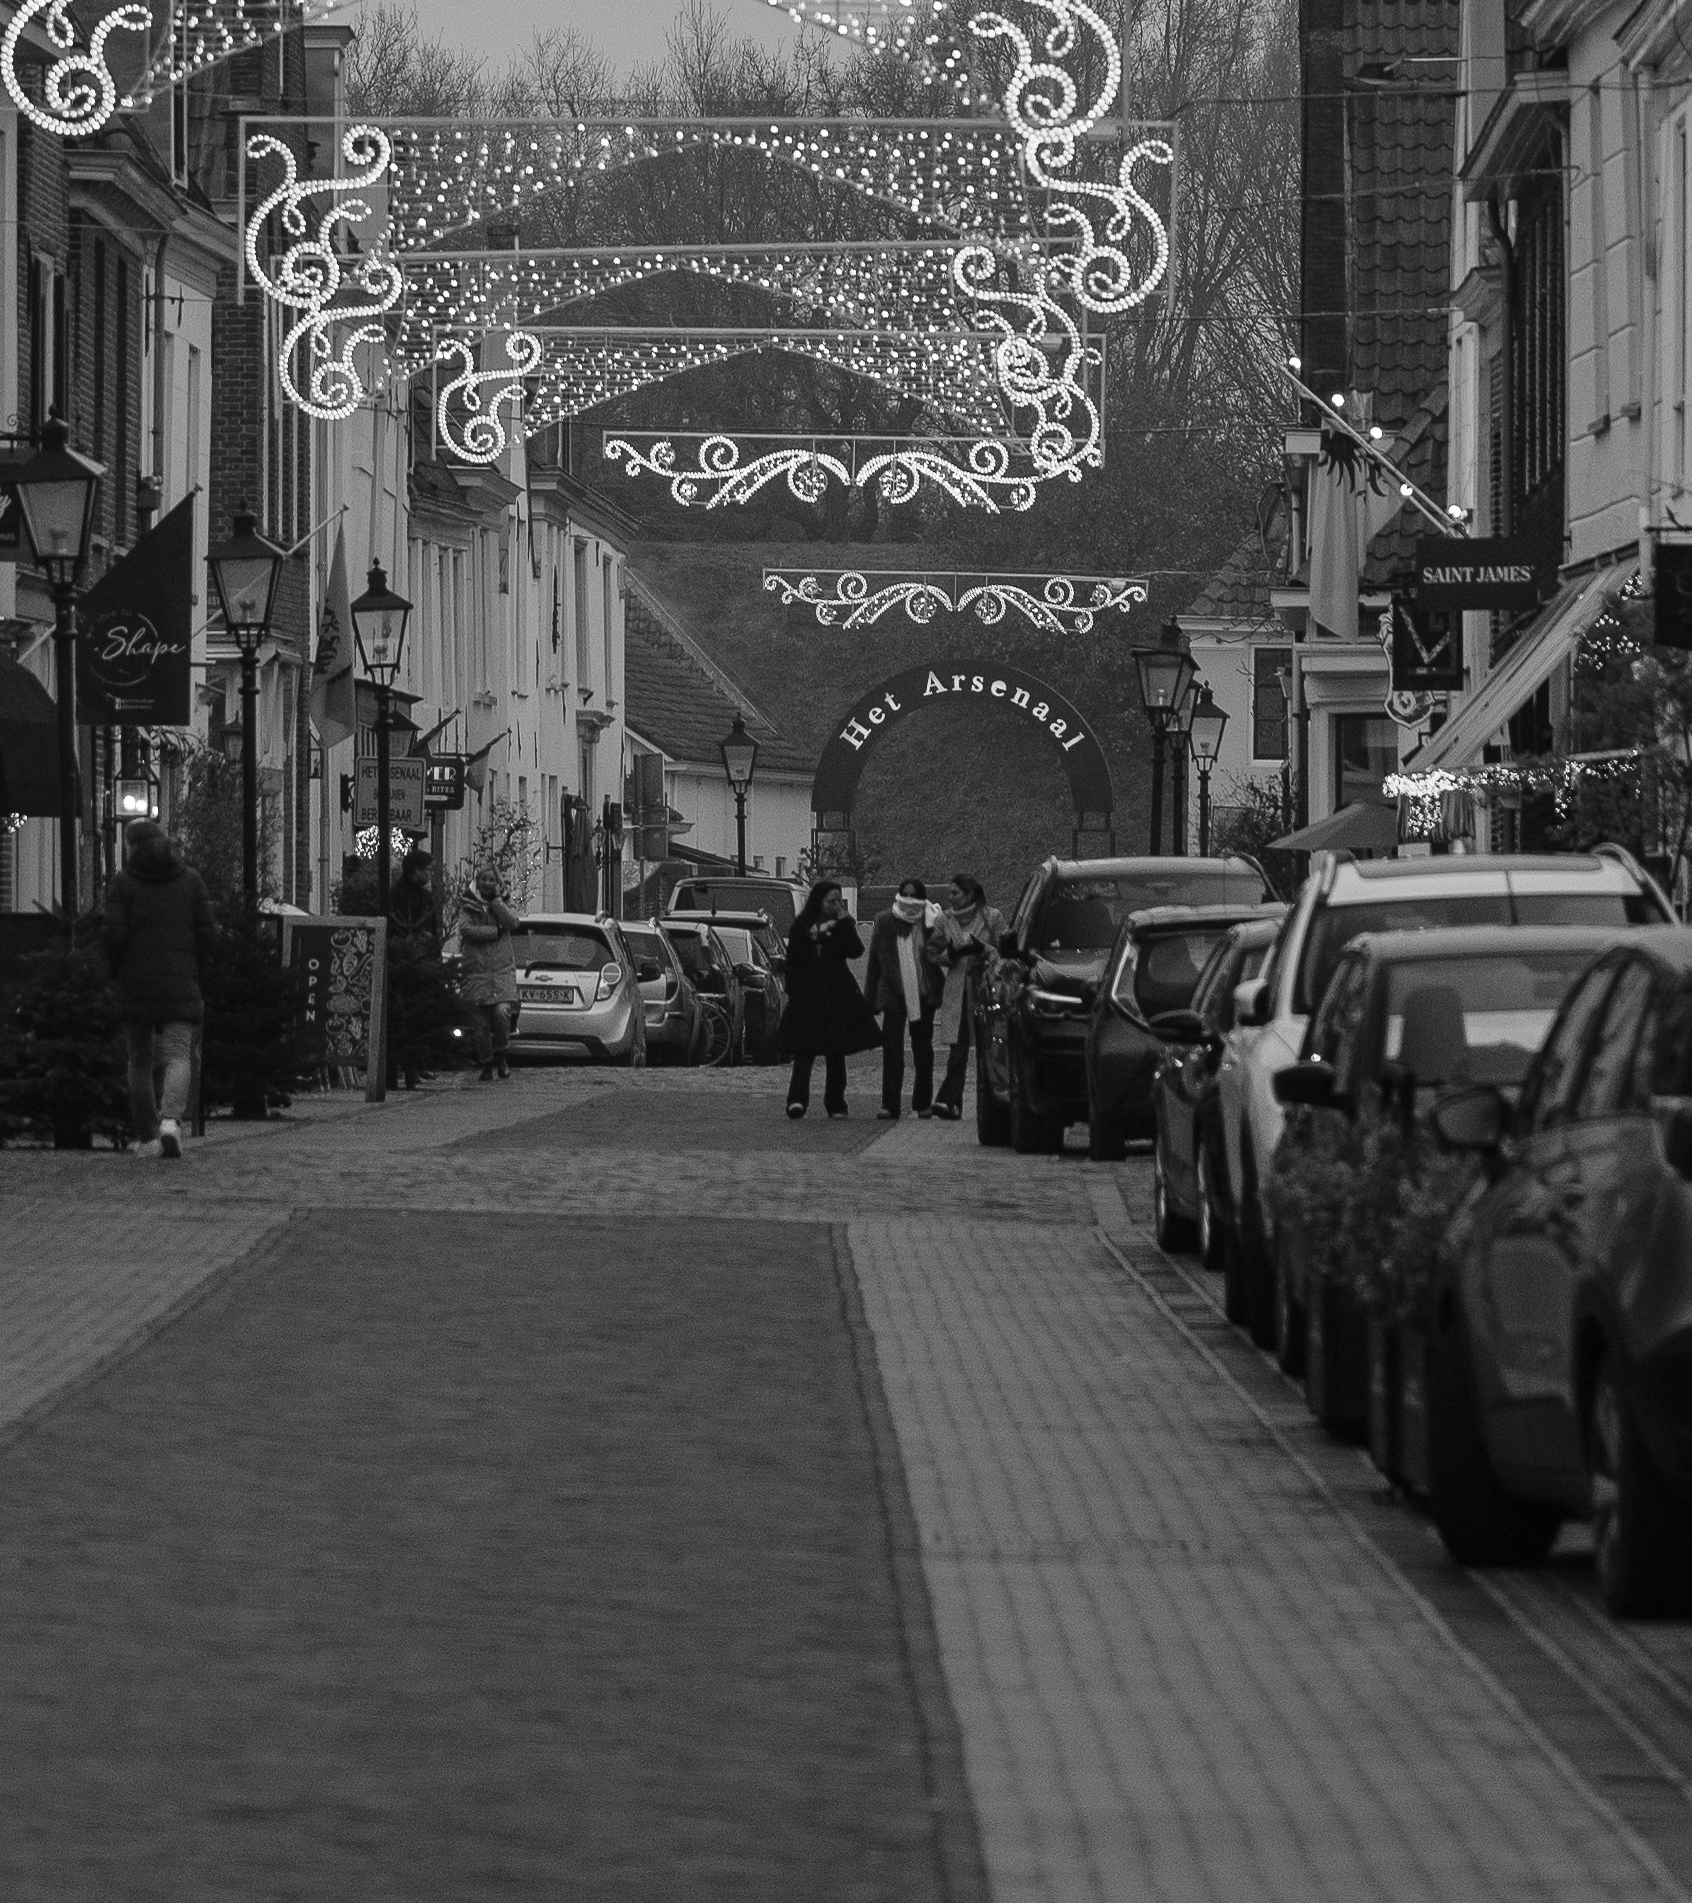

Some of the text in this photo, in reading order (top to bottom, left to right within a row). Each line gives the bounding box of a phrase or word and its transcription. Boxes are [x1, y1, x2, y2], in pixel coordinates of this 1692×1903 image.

[1423, 565, 1532, 584] SAINT JAMES
[102, 625, 186, 664] Shape
[839, 670, 1086, 752] Het Arsenaal
[361, 765, 421, 781] HET SENAAL
[305, 958, 320, 1022] OPEN
